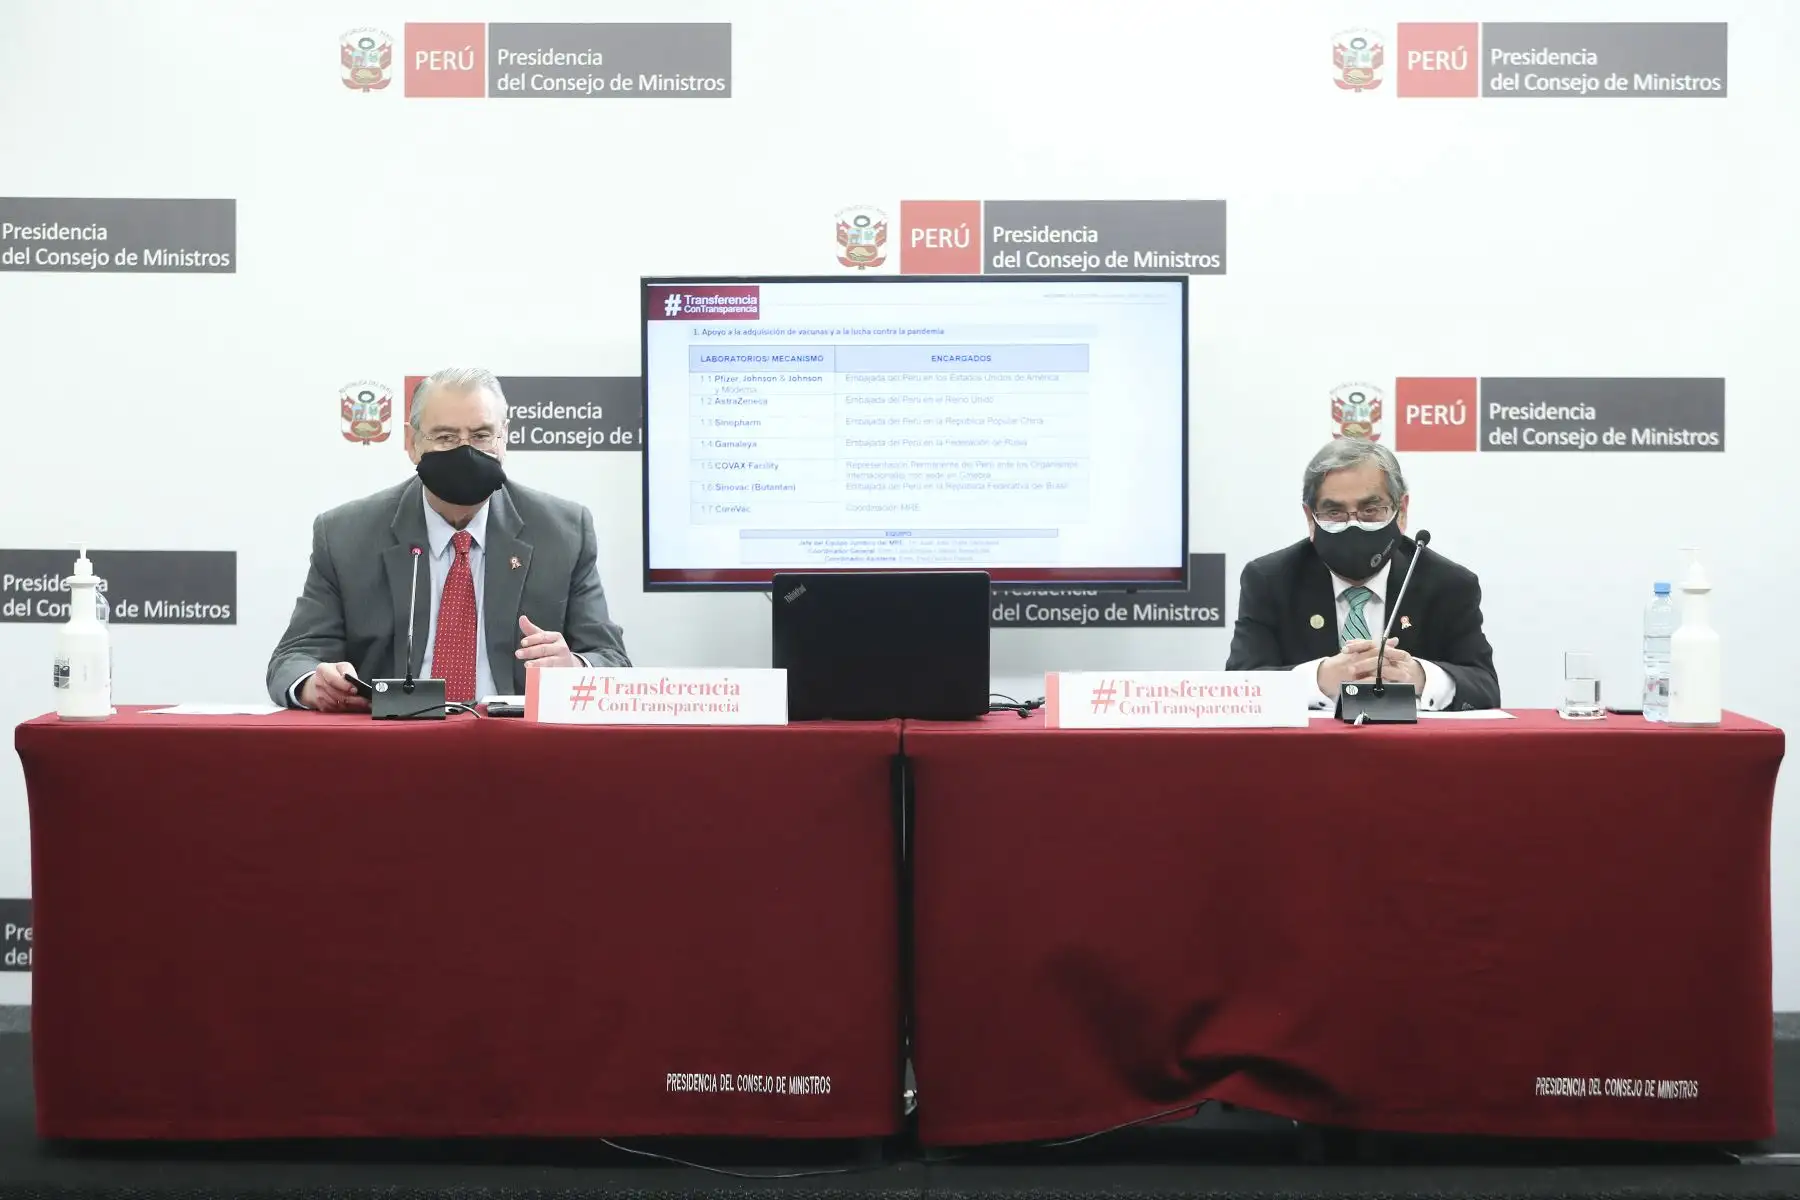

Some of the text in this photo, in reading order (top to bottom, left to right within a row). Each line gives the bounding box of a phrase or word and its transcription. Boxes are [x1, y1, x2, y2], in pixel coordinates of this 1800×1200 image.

[415, 46, 475, 71] PERÚ
[497, 48, 603, 66] Presidencia
[1407, 45, 1468, 71] PERÚ
[1490, 48, 1598, 66] Presidencia
[497, 74, 726, 95] del Consejo de Ministros
[1490, 73, 1721, 95] del Consejo de Ministros
[2, 222, 108, 241] Presidencia
[911, 223, 970, 248] PERÚ
[993, 226, 1098, 244] Presidencia
[2, 247, 230, 269] del Consejo de Ministros
[992, 250, 1220, 272] del Consejo de Ministros
[684, 305, 758, 315] ConTransparencia
[702, 328, 726, 336] Apoyo
[734, 328, 742, 336] la
[743, 328, 785, 336] adquisición
[787, 328, 796, 336] de
[798, 328, 828, 336] vacunas
[842, 328, 850, 336] la
[851, 328, 872, 336] lucha
[873, 328, 897, 336] contra
[899, 328, 906, 336] la
[907, 328, 945, 336] pandemia
[771, 355, 824, 363] MECANISMO
[931, 354, 993, 363] ENCARGADOS
[506, 401, 603, 419] residencia
[714, 397, 768, 405] AstraZeneca
[1406, 399, 1466, 425] PERÚ
[1489, 402, 1596, 420] Presidencia
[715, 418, 762, 428] Sinopharm
[506, 426, 525, 444] el
[531, 427, 604, 448] Consejo
[610, 426, 633, 444] de
[715, 440, 758, 449] Gamaleya
[1488, 427, 1719, 449] del Consejo de Ministros
[715, 462, 745, 470] COVAX
[748, 462, 779, 471] Facility
[715, 483, 749, 491] Sinovac
[751, 483, 796, 492] (Butantan)
[3, 574, 108, 592] Presidea
[3, 599, 31, 616] del
[115, 600, 139, 617] de
[144, 601, 231, 619] Ministros
[992, 603, 1219, 625] del Consejo de Ministros
[598, 698, 739, 716] ConTransparencia
[1119, 700, 1262, 719] ConTransparencia
[5, 946, 32, 967] del
[666, 1073, 831, 1095] PRESIDENCIA DEL CONSEJO DE MINISTROS
[1535, 1077, 1698, 1099] PRESIDENCIA DEL CONSEJO DE MINISTROS
